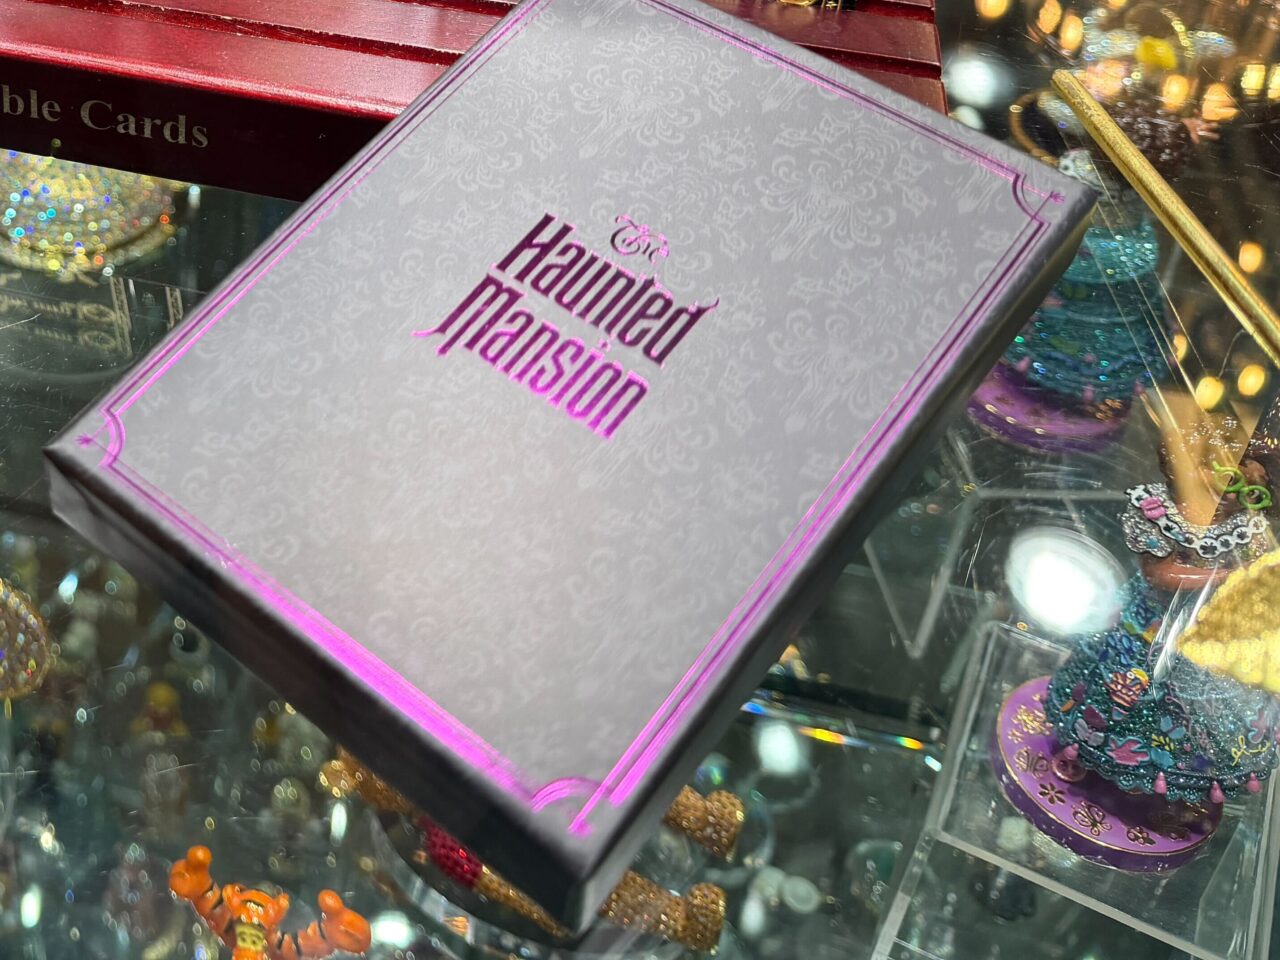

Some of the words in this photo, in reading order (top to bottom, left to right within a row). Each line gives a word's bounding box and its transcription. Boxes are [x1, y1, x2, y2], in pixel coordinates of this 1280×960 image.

[79, 99, 210, 148] Cards
[489, 210, 720, 370] Haunted
[610, 214, 670, 264] The
[410, 272, 650, 441] Mansion
